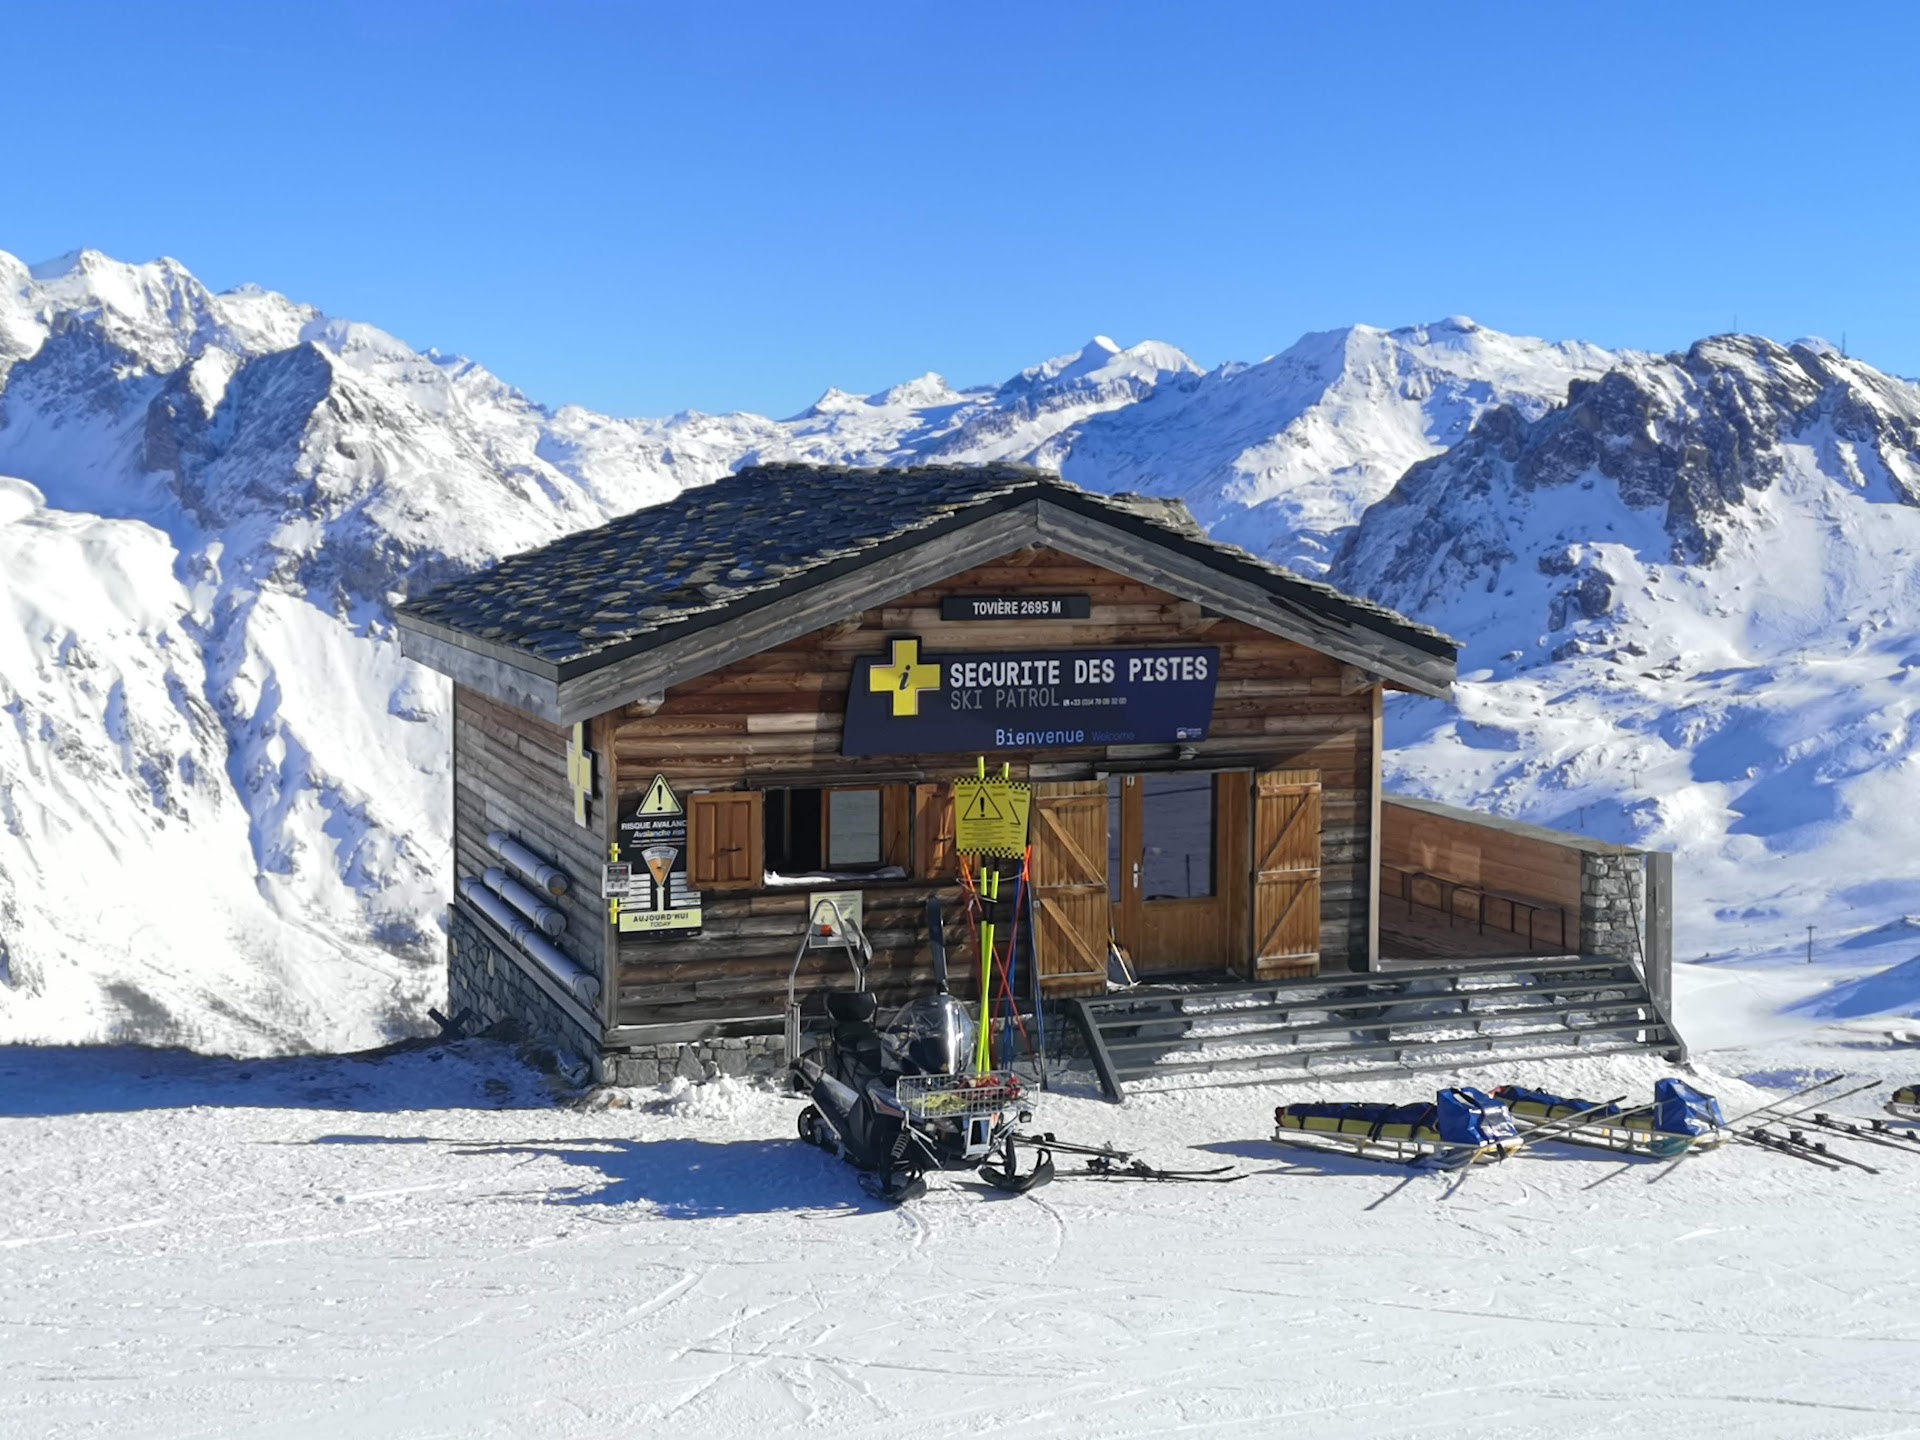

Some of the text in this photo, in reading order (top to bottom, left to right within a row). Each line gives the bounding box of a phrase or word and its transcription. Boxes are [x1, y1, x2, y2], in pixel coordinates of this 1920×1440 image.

[973, 599, 1061, 615] TOVIÈRE 2695 M
[950, 656, 1208, 688] SECURITE DES PISTES
[951, 687, 1060, 710] SKI PATROL
[996, 729, 1135, 745] Bienvenue Welcome
[621, 820, 688, 830] RISQUE AVALANC
[633, 830, 671, 838] Avalanche
[633, 912, 689, 923] AUJOURD'HUI
